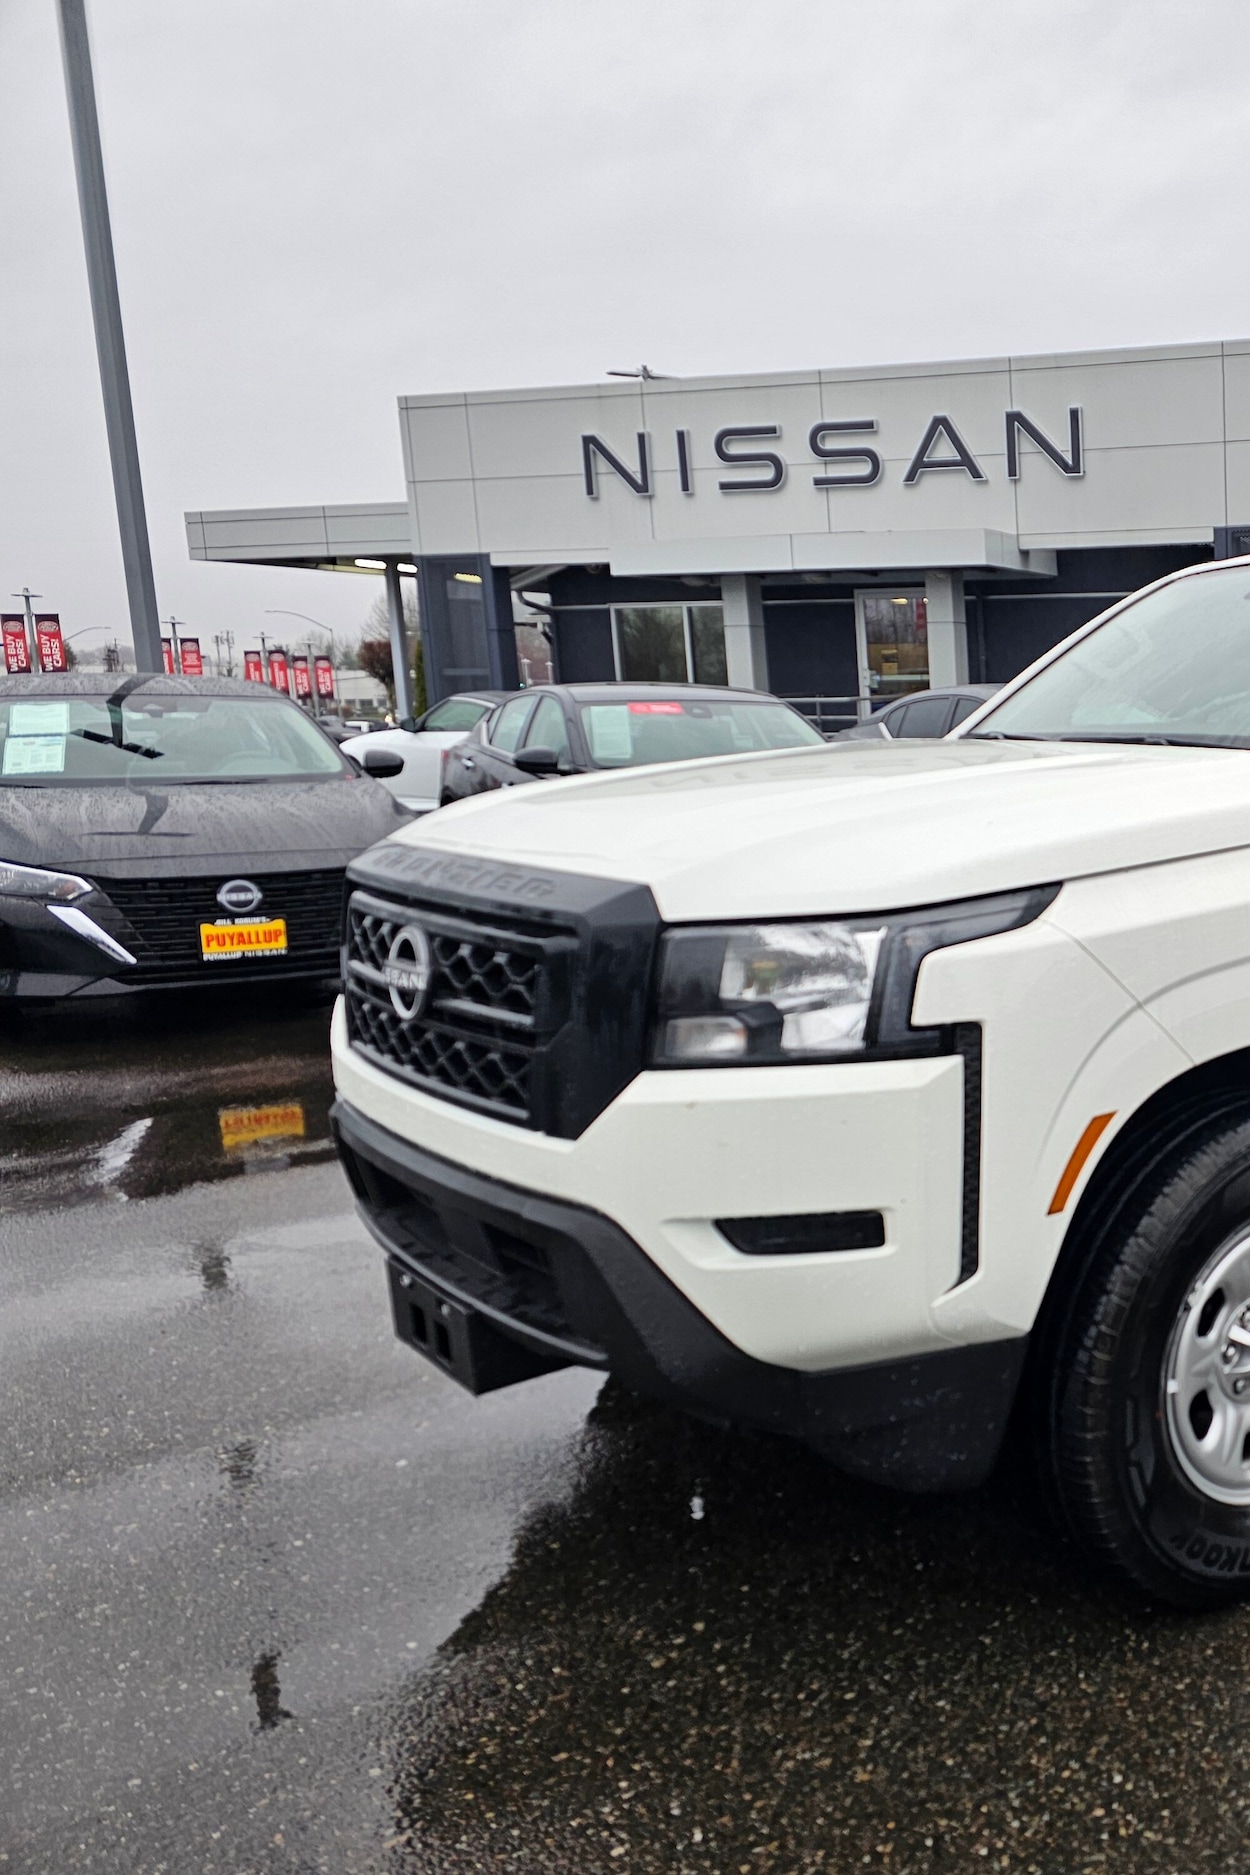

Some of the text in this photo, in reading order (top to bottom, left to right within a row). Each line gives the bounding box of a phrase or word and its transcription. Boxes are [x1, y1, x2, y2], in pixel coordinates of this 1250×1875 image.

[581, 405, 1085, 500] NISSAN
[5, 634, 16, 655] BUY
[15, 639, 26, 668] CARS!
[40, 634, 51, 655] BUY
[50, 639, 61, 668] CARS!
[8, 655, 18, 671] WE
[43, 655, 53, 671] WE
[205, 928, 283, 949] PUYALLUP
